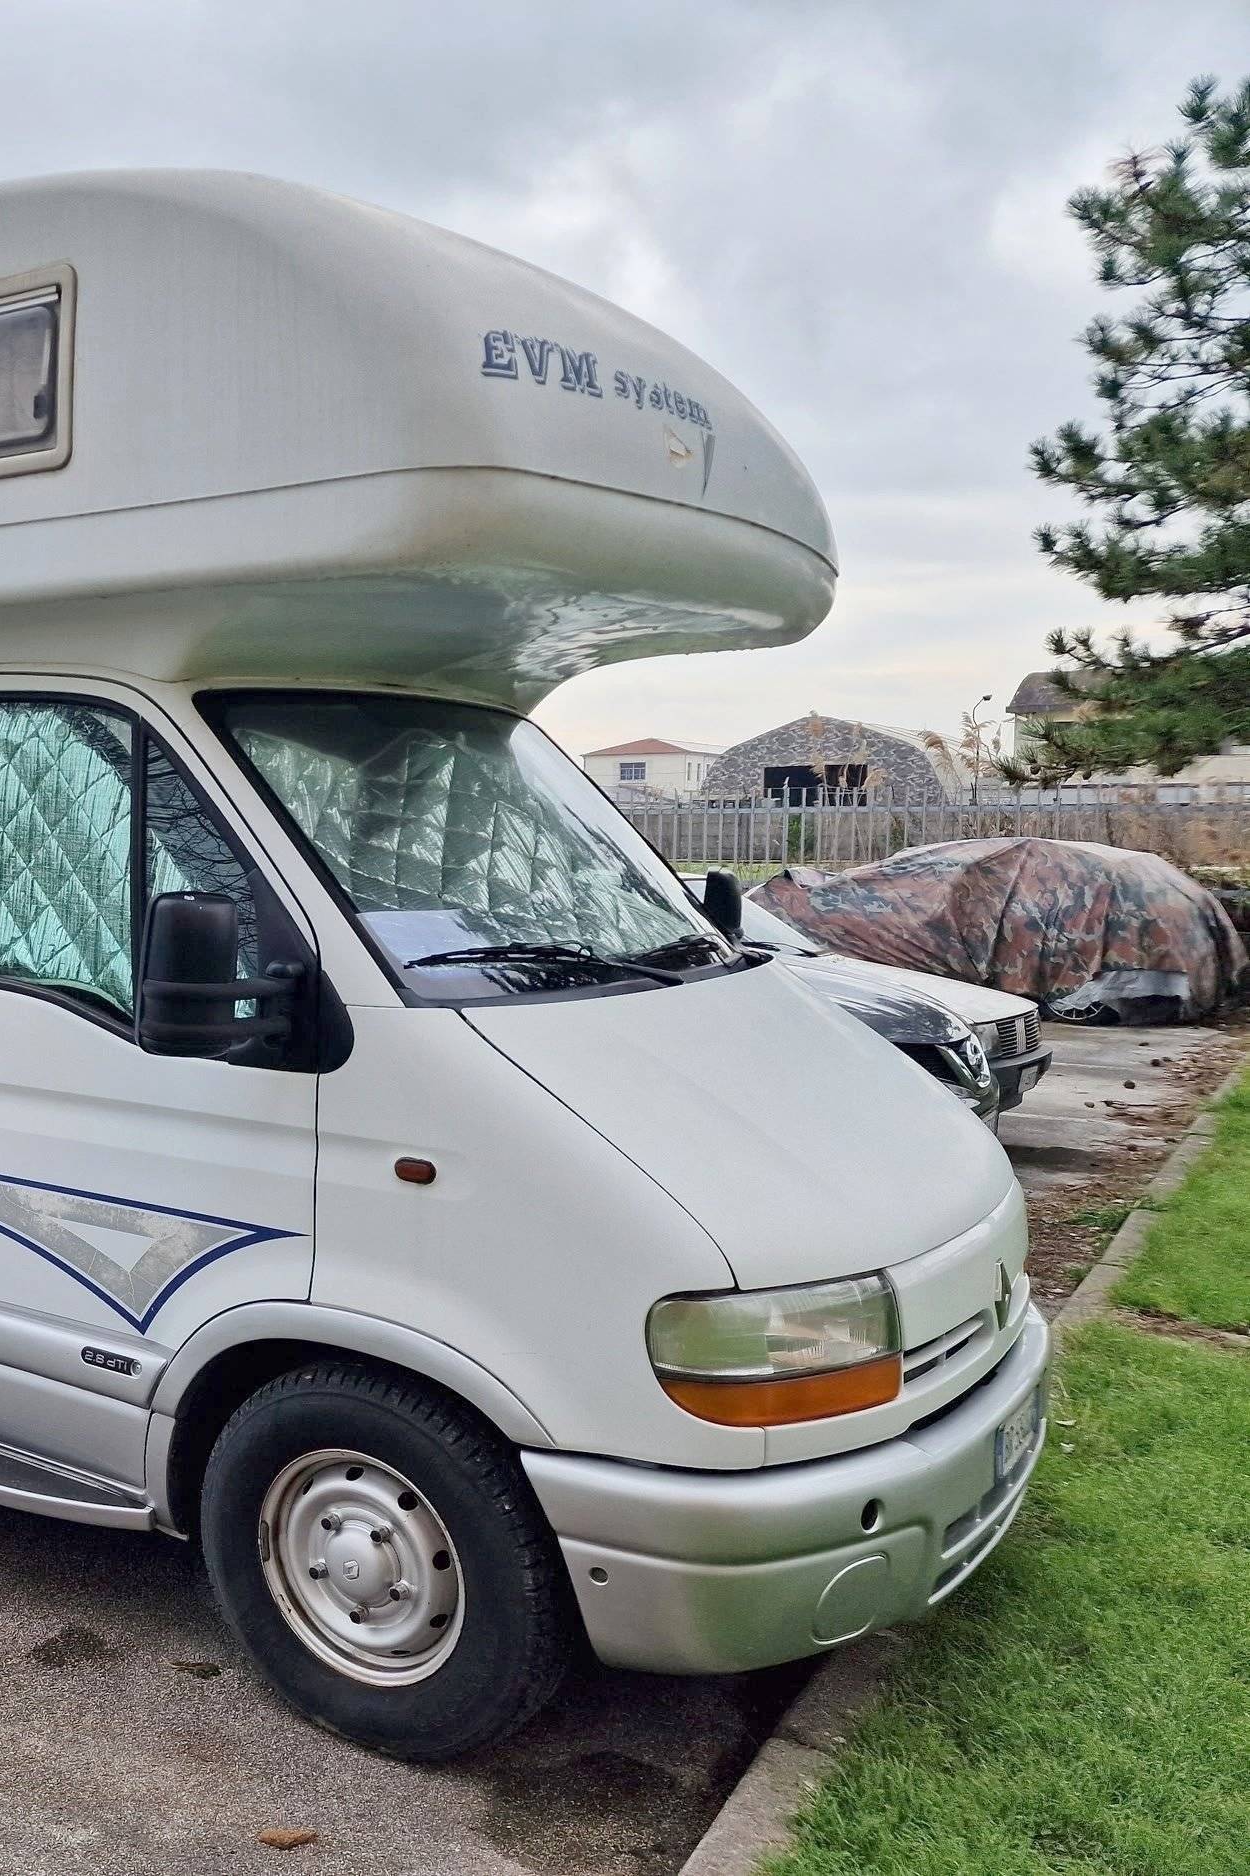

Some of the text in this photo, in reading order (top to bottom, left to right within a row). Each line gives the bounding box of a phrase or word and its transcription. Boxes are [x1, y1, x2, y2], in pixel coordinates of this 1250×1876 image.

[481, 330, 712, 431] EVM system
[84, 1350, 105, 1365] 2.8
